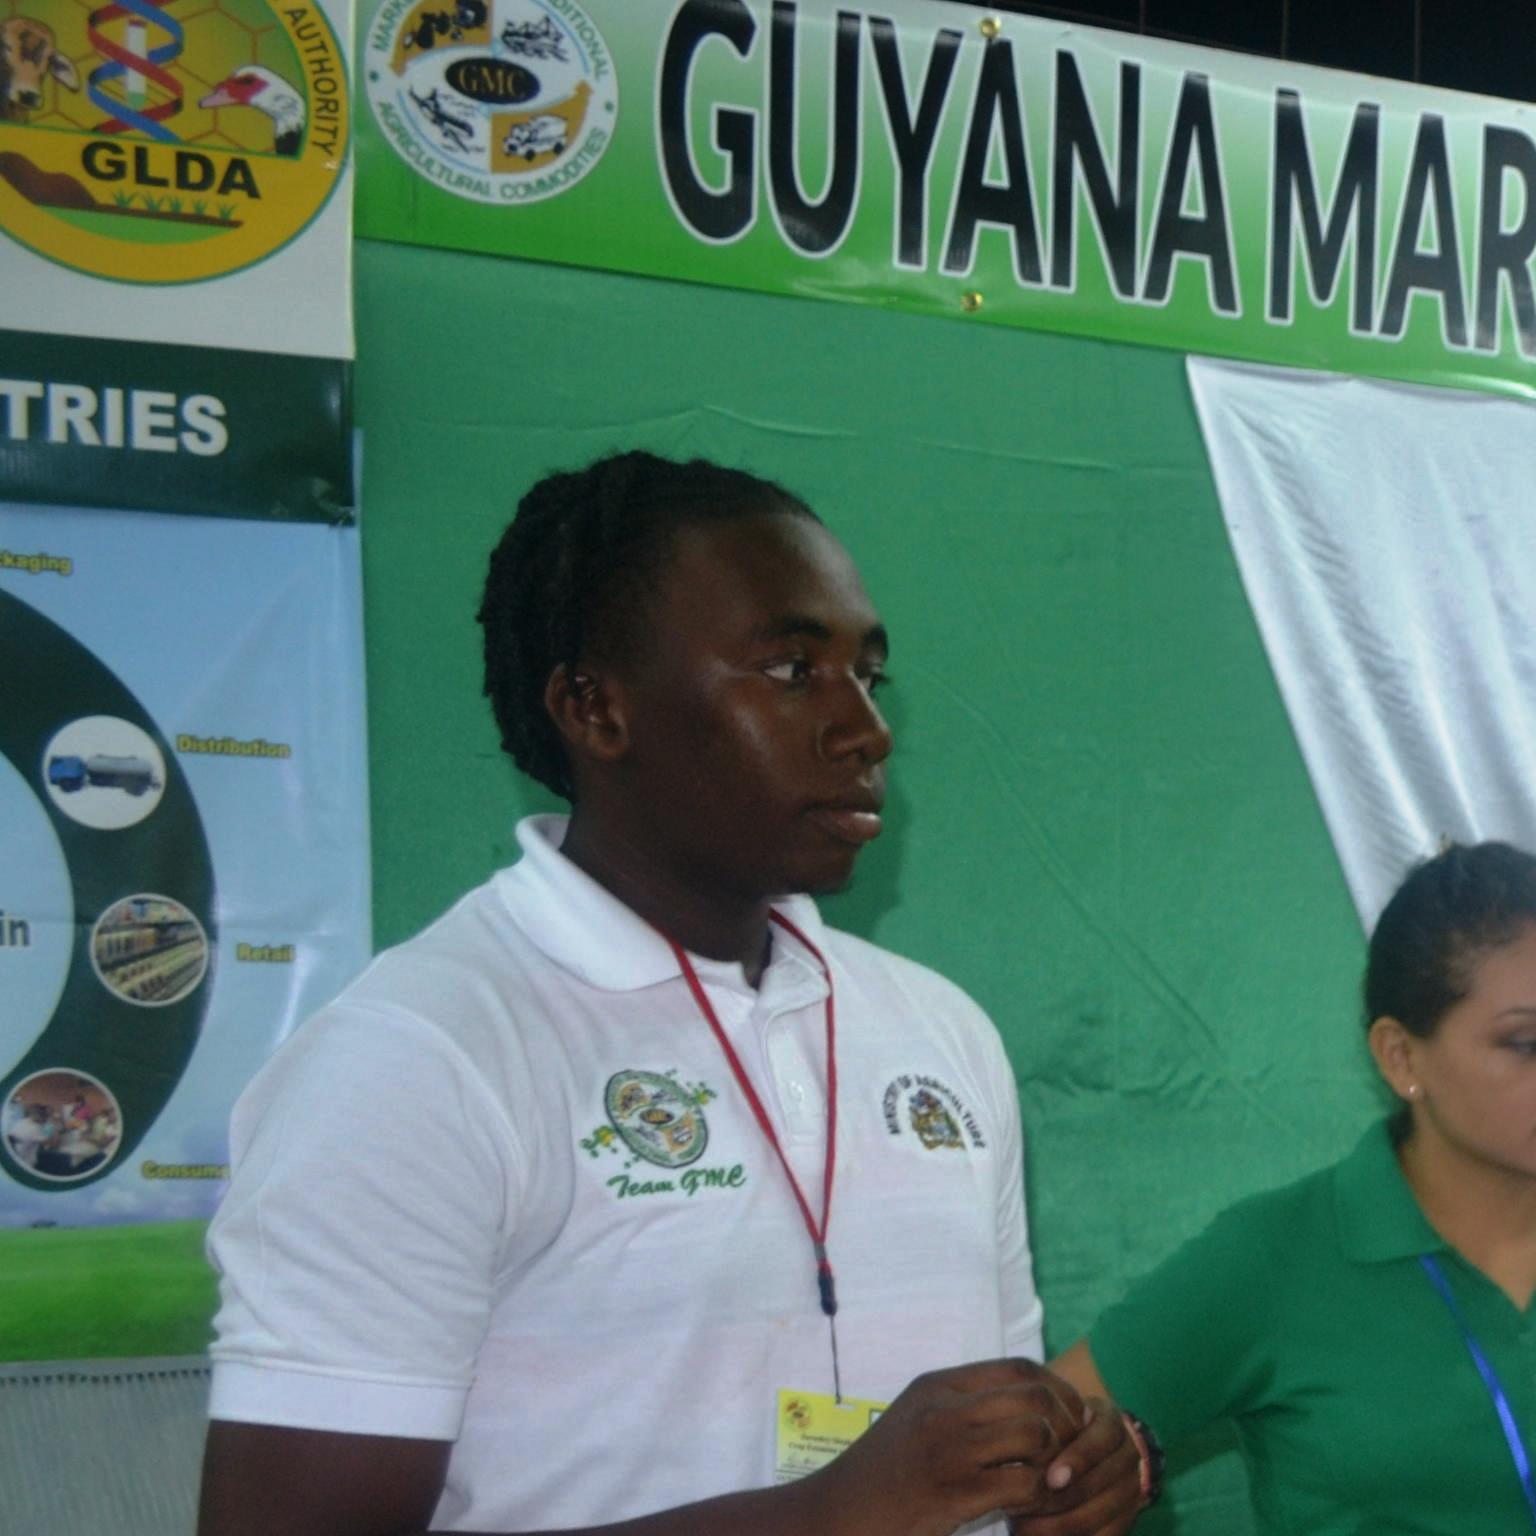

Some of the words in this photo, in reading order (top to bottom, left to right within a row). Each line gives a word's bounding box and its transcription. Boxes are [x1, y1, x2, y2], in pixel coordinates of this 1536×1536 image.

[285, 8, 341, 157] AUTHORITY
[458, 64, 526, 98] GMC
[80, 140, 262, 200] GLDA
[378, 101, 492, 197] AGRICULTURAL
[500, 127, 608, 199] COMMODITIES
[656, 0, 1240, 316] GUYANA
[176, 734, 292, 759] Distribution
[236, 942, 297, 964] Retail
[607, 1173, 676, 1199] Team
